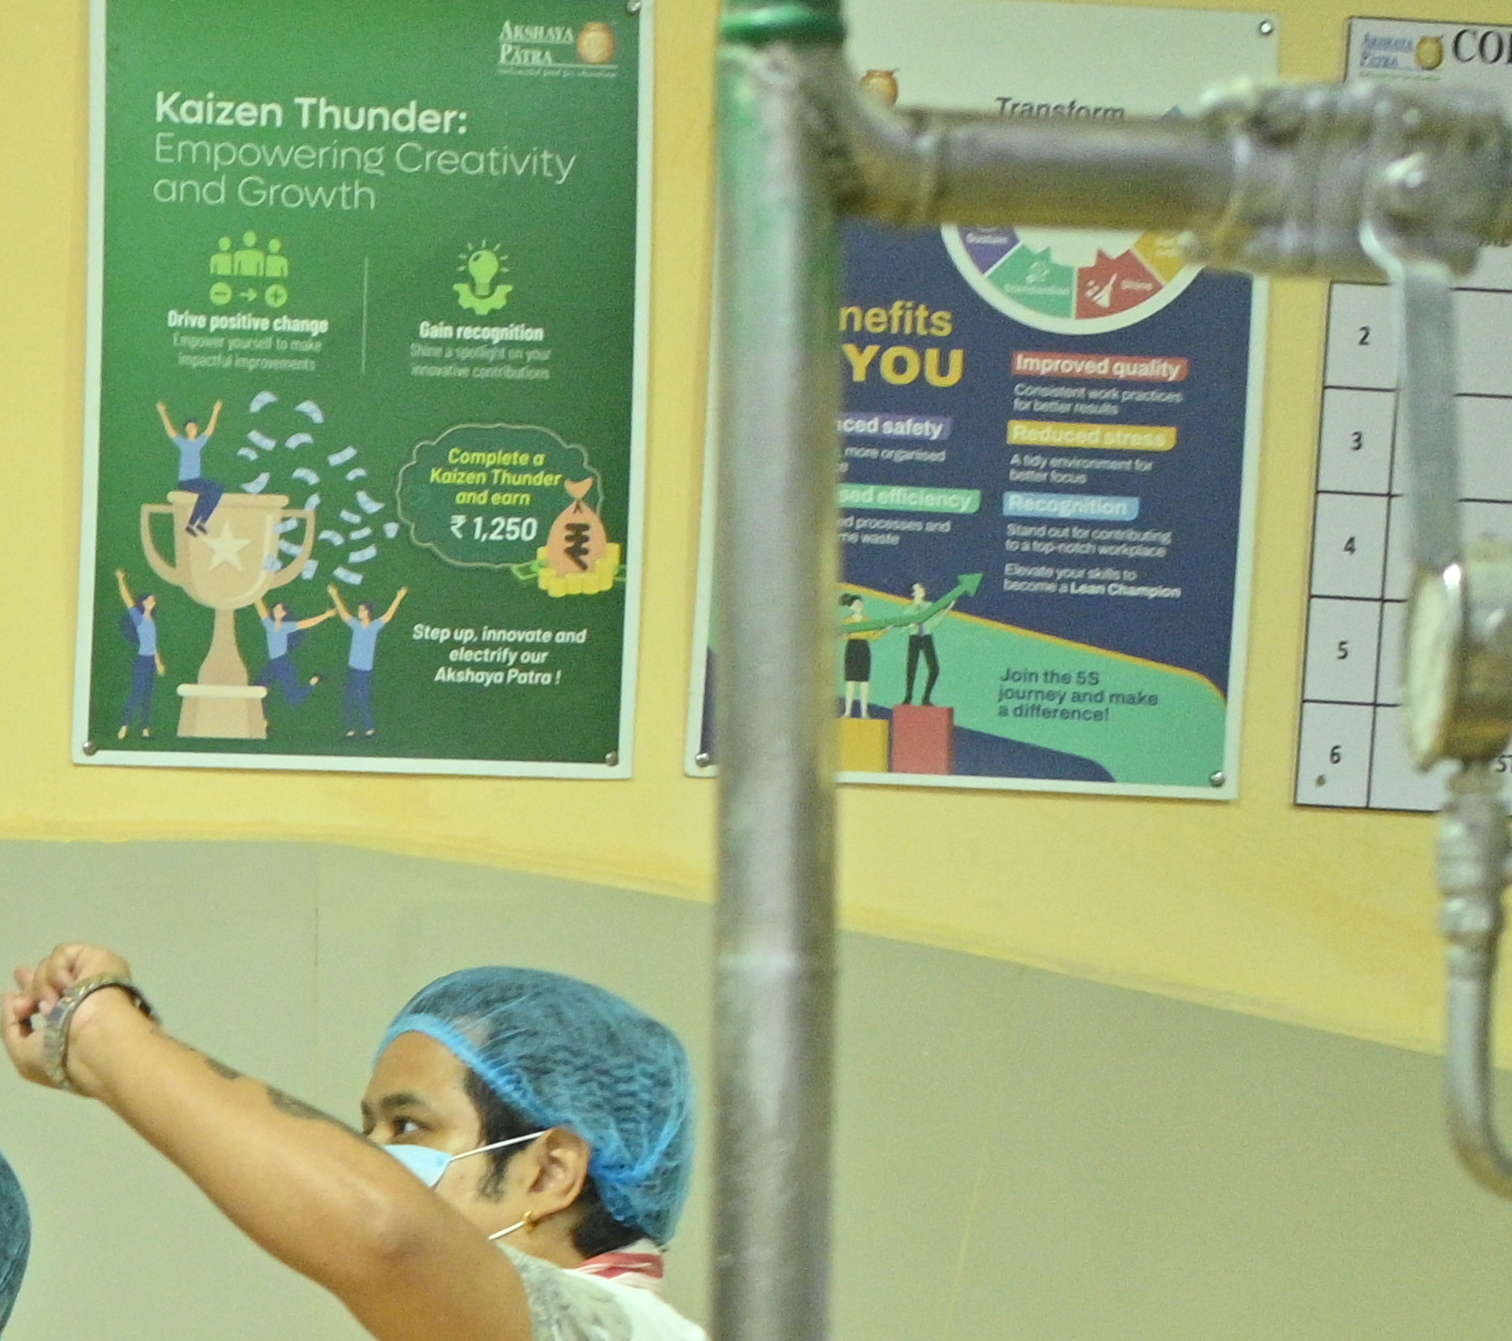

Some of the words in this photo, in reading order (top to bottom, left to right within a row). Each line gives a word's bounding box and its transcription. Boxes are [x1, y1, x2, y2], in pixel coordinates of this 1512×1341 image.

[155, 90, 284, 128] Kaizen
[293, 95, 468, 135] Thunder:
[995, 96, 1126, 124] Transform
[154, 132, 385, 177] Empowering
[395, 141, 577, 184] Creativity
[153, 175, 227, 205] and
[237, 176, 376, 211] Growth
[167, 309, 207, 328] Drive
[209, 311, 270, 334] positive
[272, 314, 329, 336] change
[839, 300, 954, 336] nefits
[418, 320, 454, 340] Gain
[455, 322, 545, 345] recognition
[1357, 325, 1371, 348] 2
[842, 344, 964, 387] YOU
[1015, 354, 1110, 375] Improved
[1112, 359, 1182, 381] quality
[882, 418, 944, 440] safety
[1011, 424, 1101, 445] Reduced
[1103, 429, 1167, 447] stress
[1350, 431, 1364, 452] 3
[447, 448, 530, 467] Complete
[533, 454, 545, 466] a
[429, 468, 487, 485] Kaizen
[491, 469, 562, 487] Thunder
[455, 489, 489, 505] and
[491, 492, 531, 506] earn
[876, 487, 974, 512] efficiency
[1008, 496, 1128, 517] Recognition
[450, 515, 467, 539] ₹
[474, 515, 539, 543] 1,250
[1343, 535, 1358, 557] 4
[1070, 583, 1107, 596] Lean
[1107, 583, 1182, 599] Champion
[412, 625, 452, 645] Step
[482, 626, 553, 643] innovate
[554, 628, 587, 644] and
[449, 646, 519, 666] electrify
[520, 651, 549, 665] our
[1336, 639, 1350, 661] 5
[433, 668, 505, 687] Akshaya
[506, 668, 552, 685] Patra
[1000, 667, 1039, 682] Join
[1043, 669, 1071, 683] the
[1075, 671, 1101, 685] 5S
[997, 687, 1068, 705] journey
[1070, 689, 1104, 703] and
[1109, 691, 1159, 707] make
[997, 705, 1008, 717] a
[1012, 703, 1110, 722] difference!
[1329, 743, 1343, 766] 6
